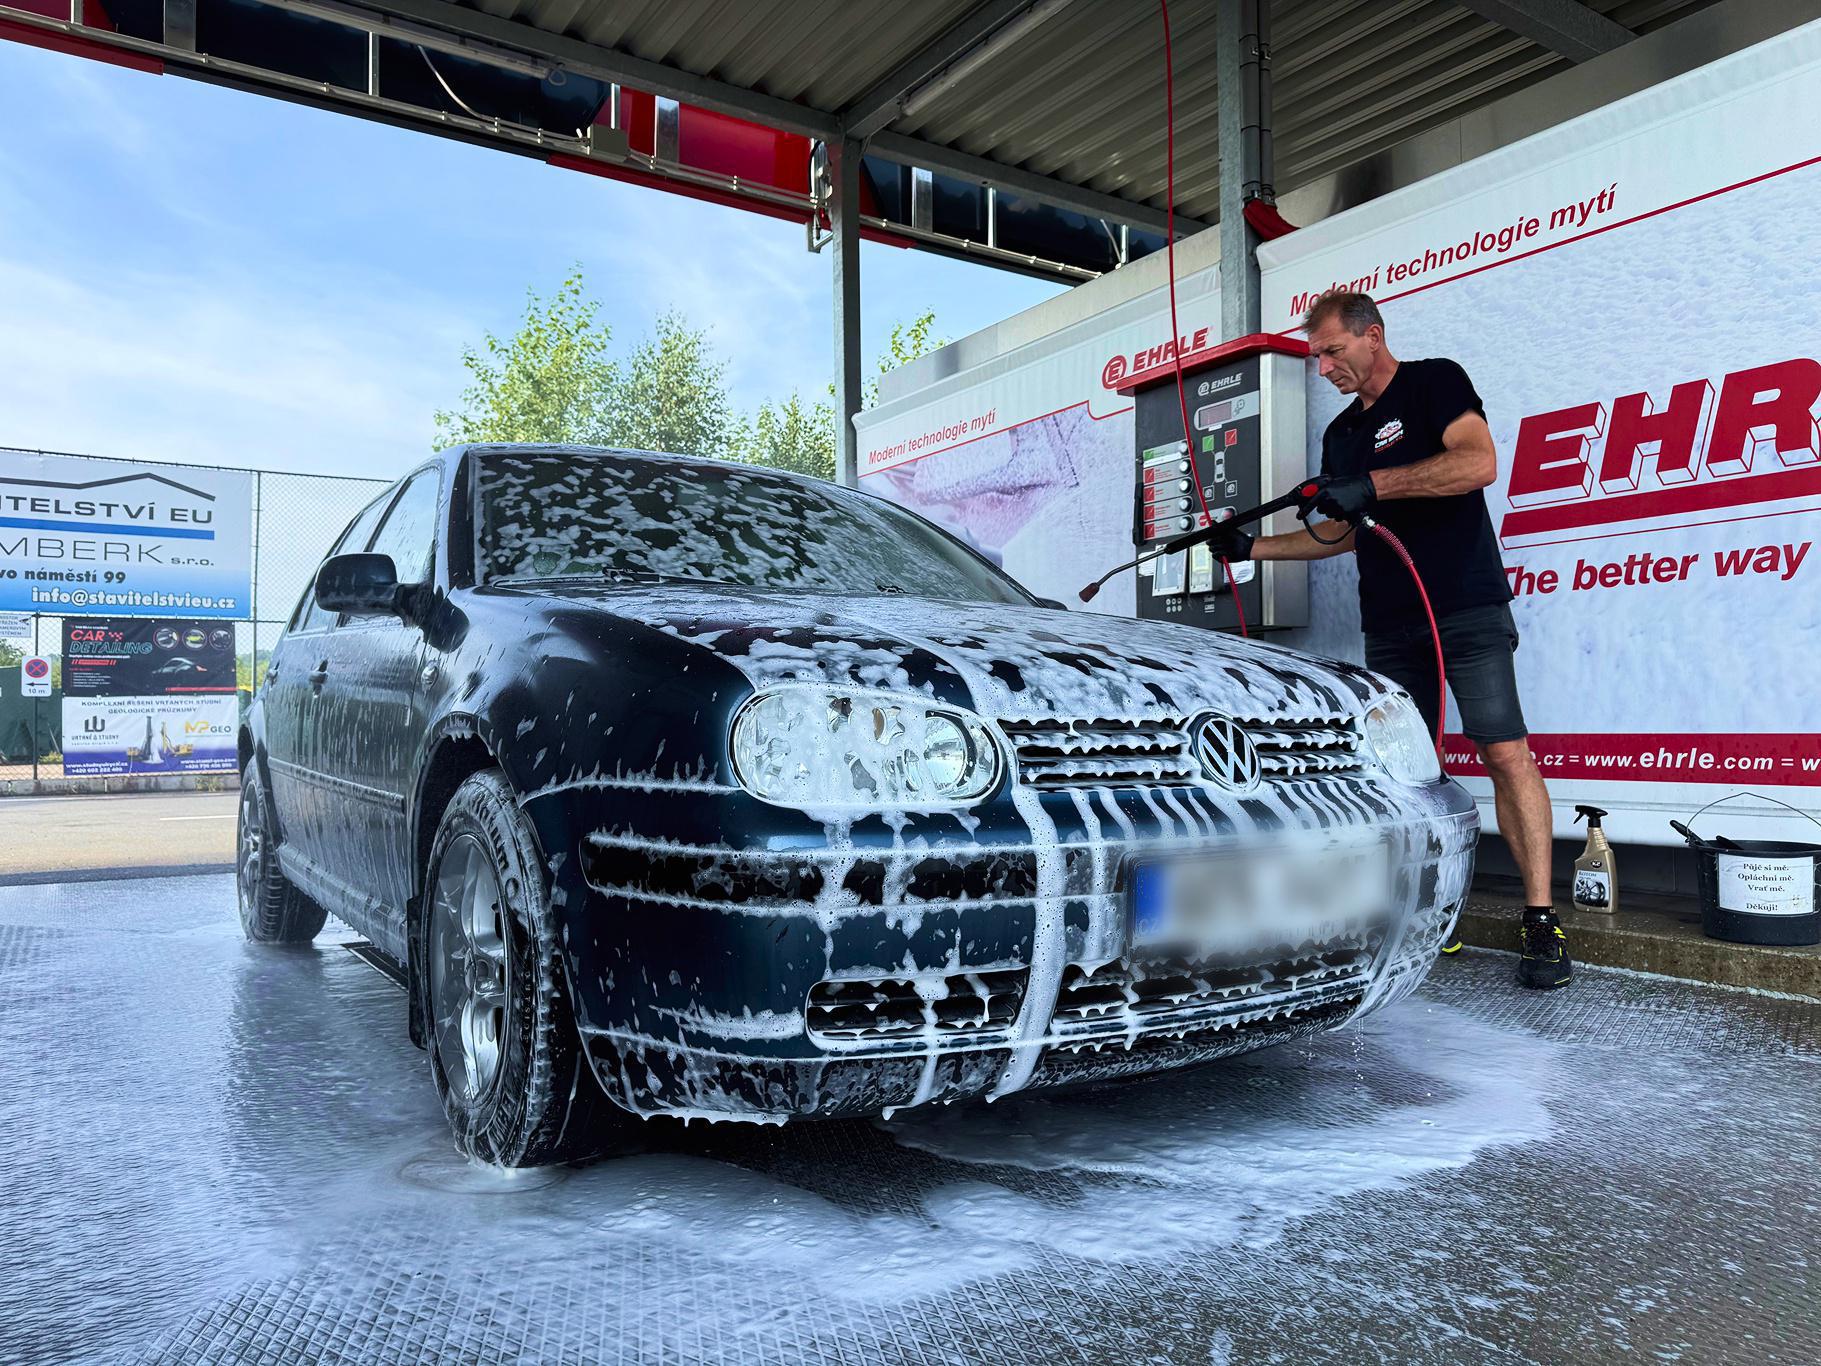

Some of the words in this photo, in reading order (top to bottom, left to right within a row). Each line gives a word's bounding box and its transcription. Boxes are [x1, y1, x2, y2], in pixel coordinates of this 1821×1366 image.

[1386, 216, 1540, 285] technologie
[1549, 182, 1618, 230] mytí
[1133, 327, 1208, 370] EHRLE
[1211, 372, 1243, 389] EHRLE
[869, 440, 906, 464] Moderní
[908, 420, 968, 451] technologie
[971, 408, 996, 431] mytí
[1507, 358, 1821, 508] EHR
[0, 495, 155, 520] TELSTVÍ
[170, 508, 212, 524] EU
[0, 537, 163, 563] MBERK
[170, 557, 215, 567] s.r.o.
[25, 567, 97, 583] náměstí
[104, 571, 126, 584] 99
[1572, 552, 1699, 591] better
[1715, 541, 1812, 580] way
[31, 586, 236, 609] info@stavitelstvieu.cz
[71, 630, 105, 641] CAR
[70, 641, 153, 655] DETAILING
[1584, 748, 1774, 770] www.ehrle.com
[1738, 873, 1777, 881] Opláchni
[1743, 863, 1763, 871] Půjč
[1746, 902, 1778, 912] Děkuji!
